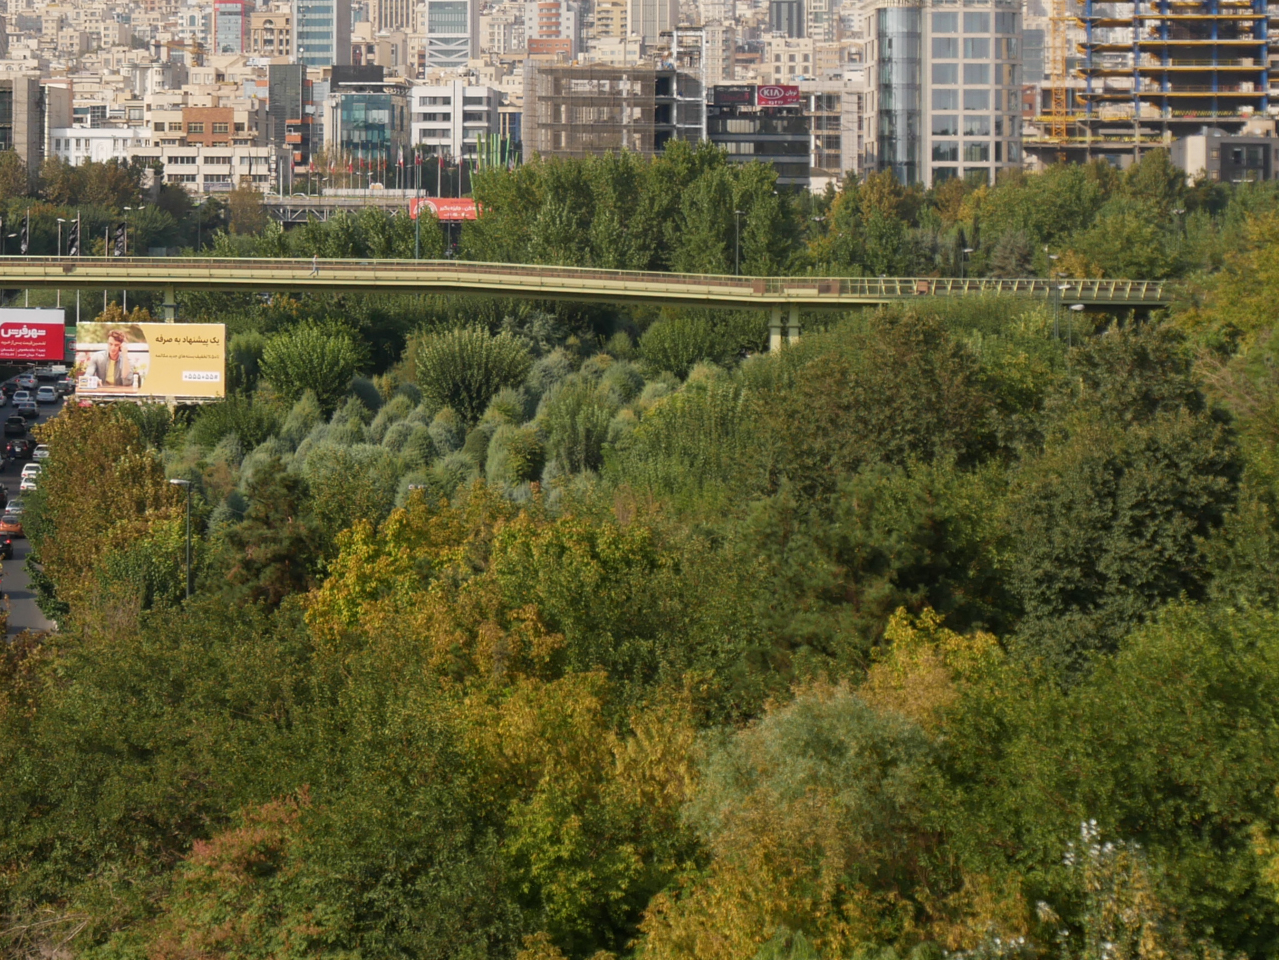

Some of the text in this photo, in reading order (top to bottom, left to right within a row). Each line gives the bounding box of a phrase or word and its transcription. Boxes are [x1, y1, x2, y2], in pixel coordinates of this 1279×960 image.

[155, 334, 173, 345] صرفه
[182, 335, 209, 347] پیشنهاد
[210, 337, 220, 346] یک
